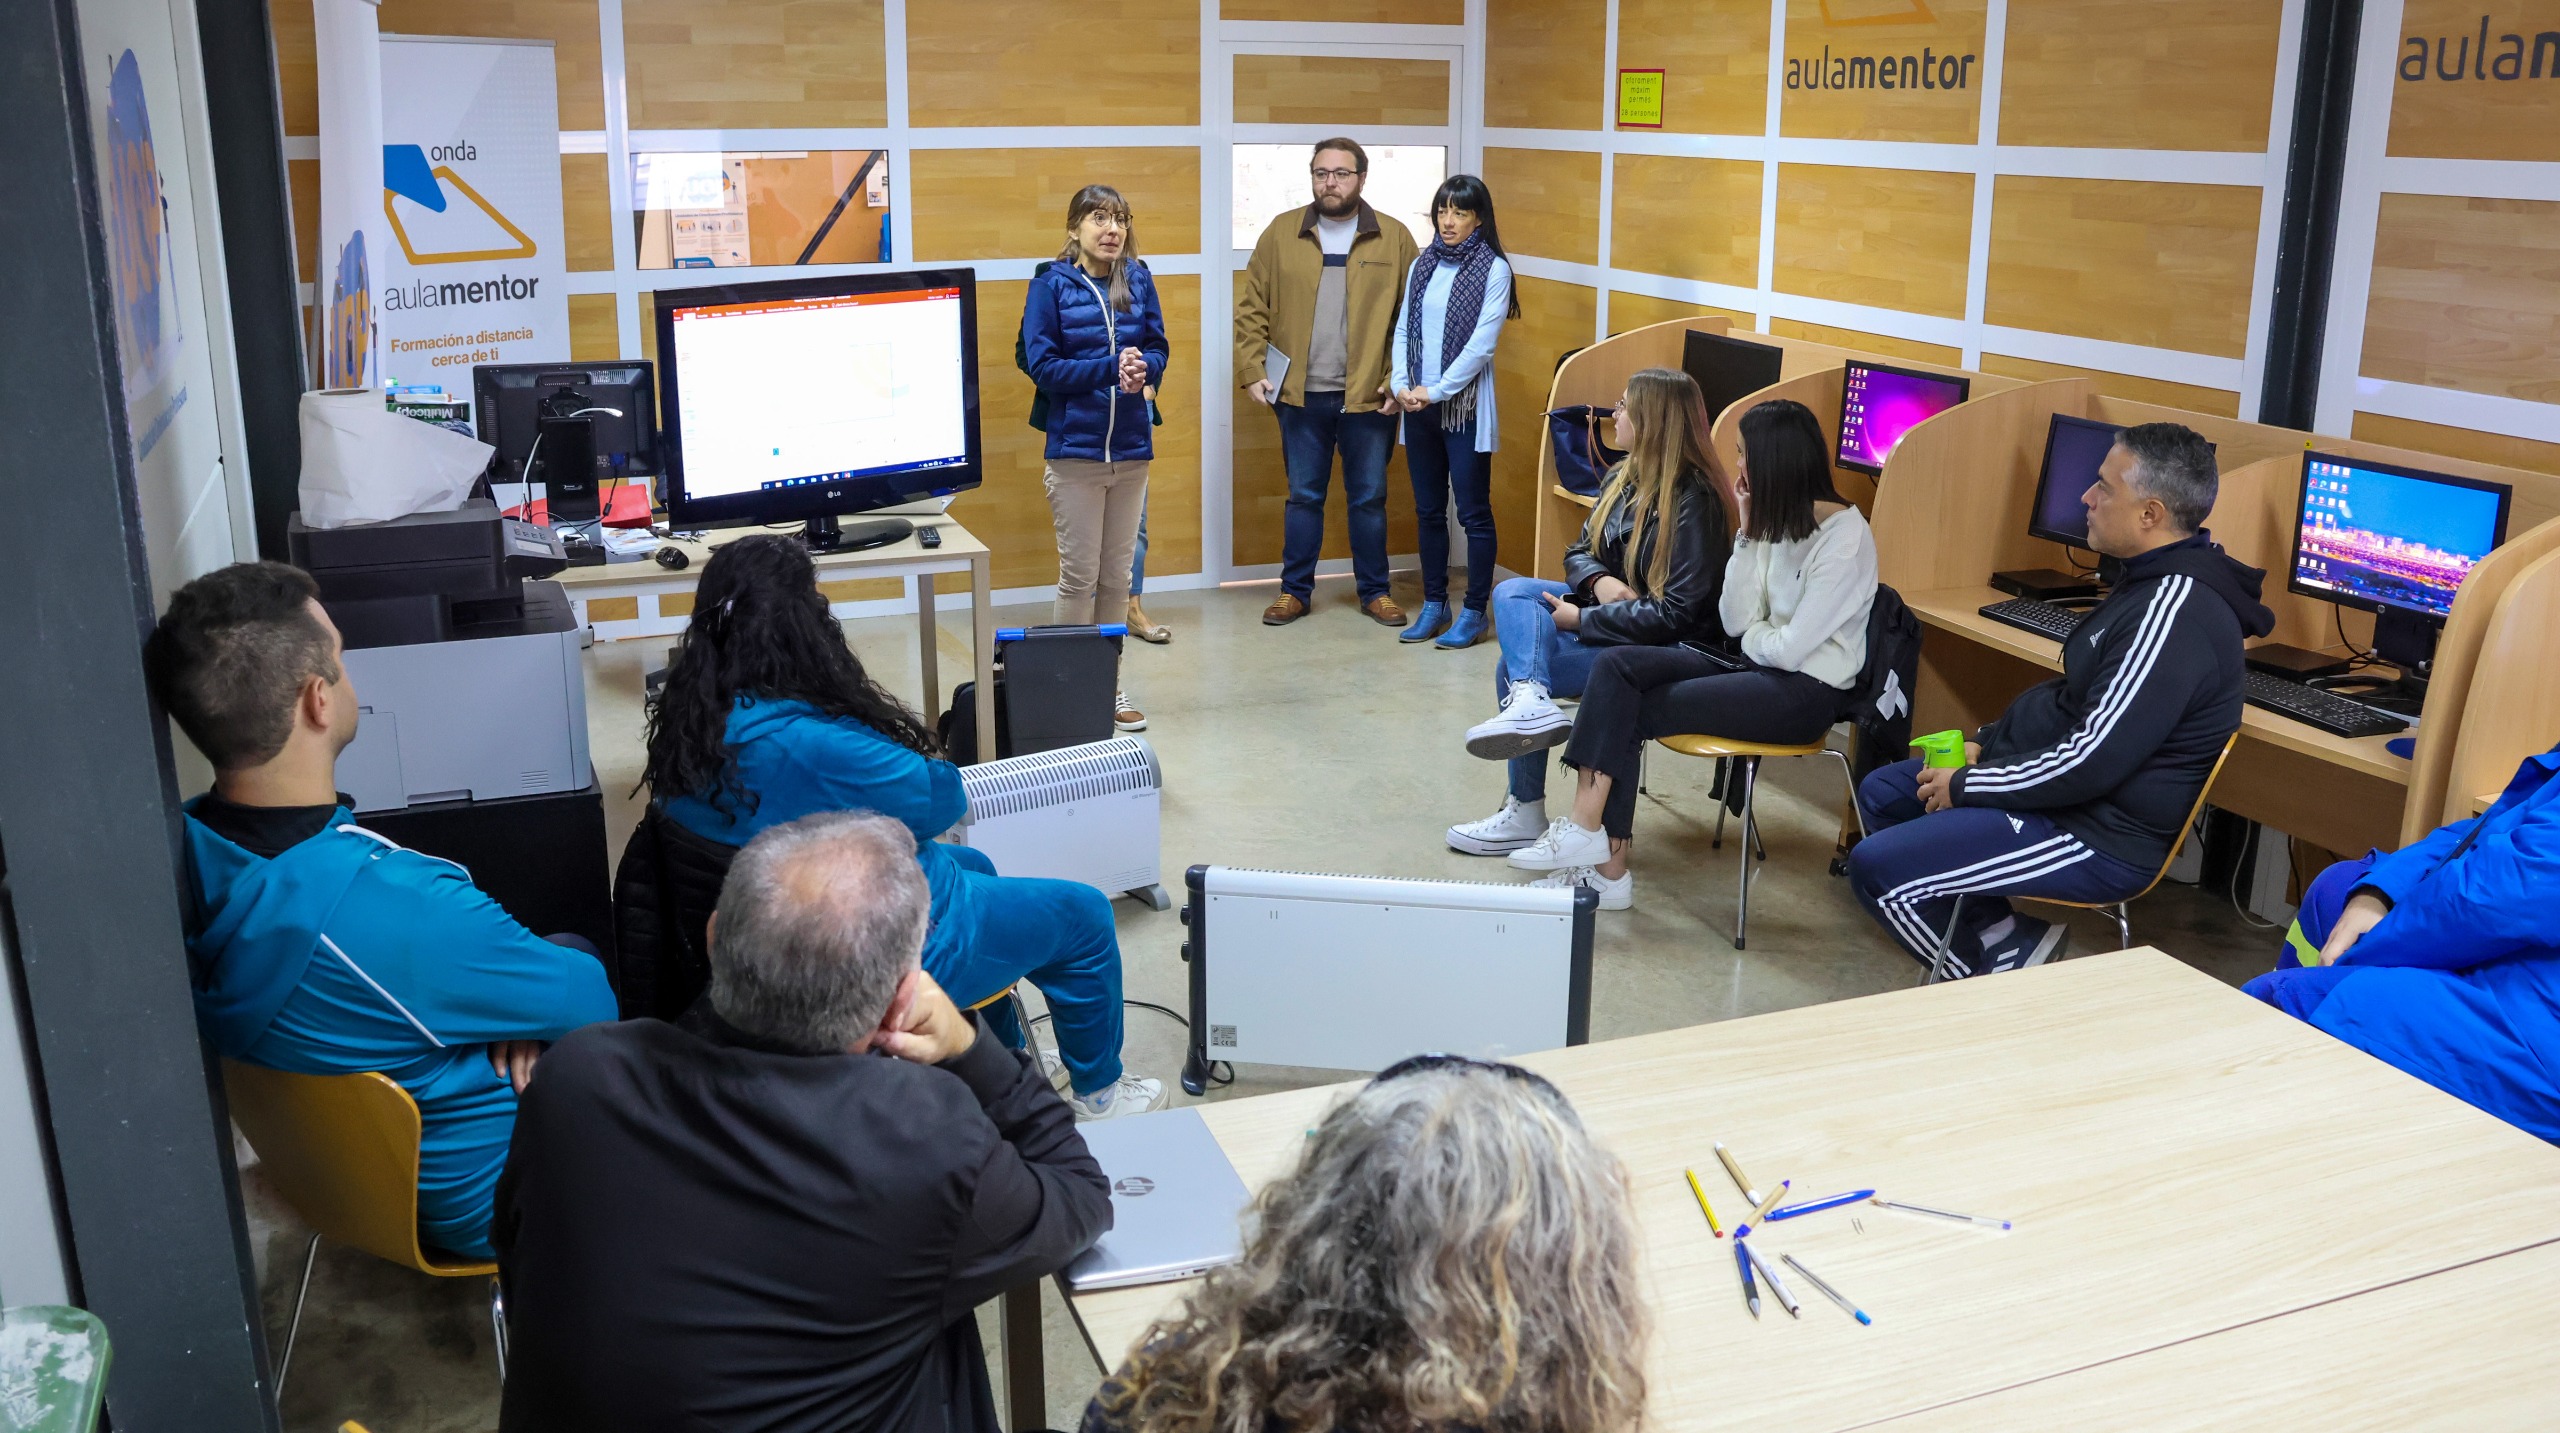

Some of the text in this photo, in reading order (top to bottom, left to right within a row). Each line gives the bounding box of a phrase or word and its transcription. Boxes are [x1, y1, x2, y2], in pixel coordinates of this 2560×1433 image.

[1787, 45, 1975, 90] aulamentor
[431, 139, 477, 161] onda
[385, 274, 539, 311] aulamentor
[391, 326, 534, 353] Formación a distancia
[431, 348, 499, 367] cerca de ti
[397, 406, 453, 420] Multicopy
